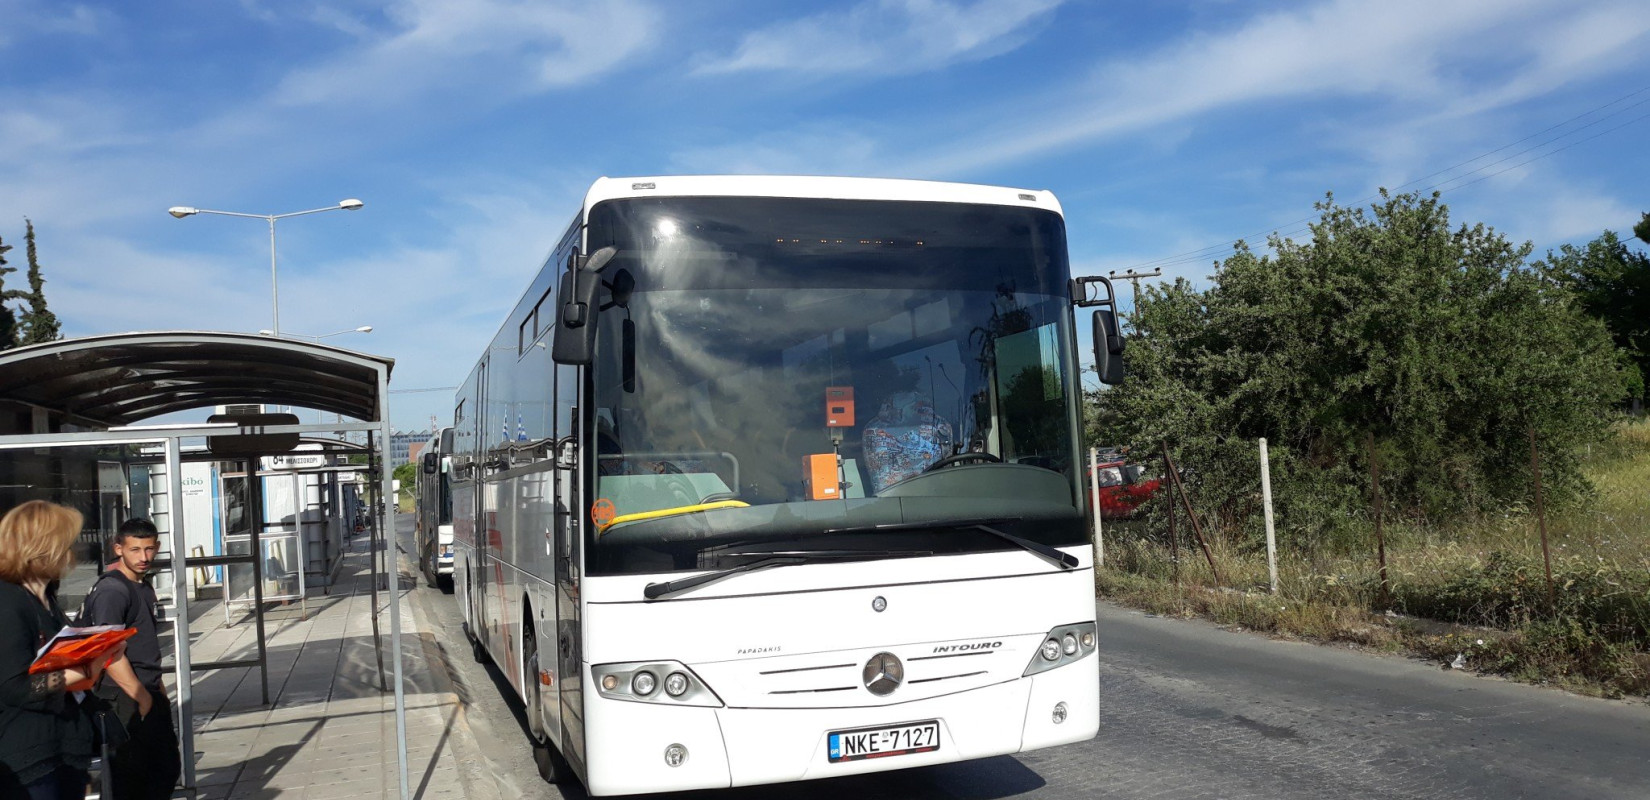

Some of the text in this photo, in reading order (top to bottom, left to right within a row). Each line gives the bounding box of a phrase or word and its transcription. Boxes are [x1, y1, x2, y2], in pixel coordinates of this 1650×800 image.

[737, 645, 782, 655] PAPADAKIS
[932, 641, 1003, 654] INTOURO
[844, 726, 934, 755] NKE-7127
